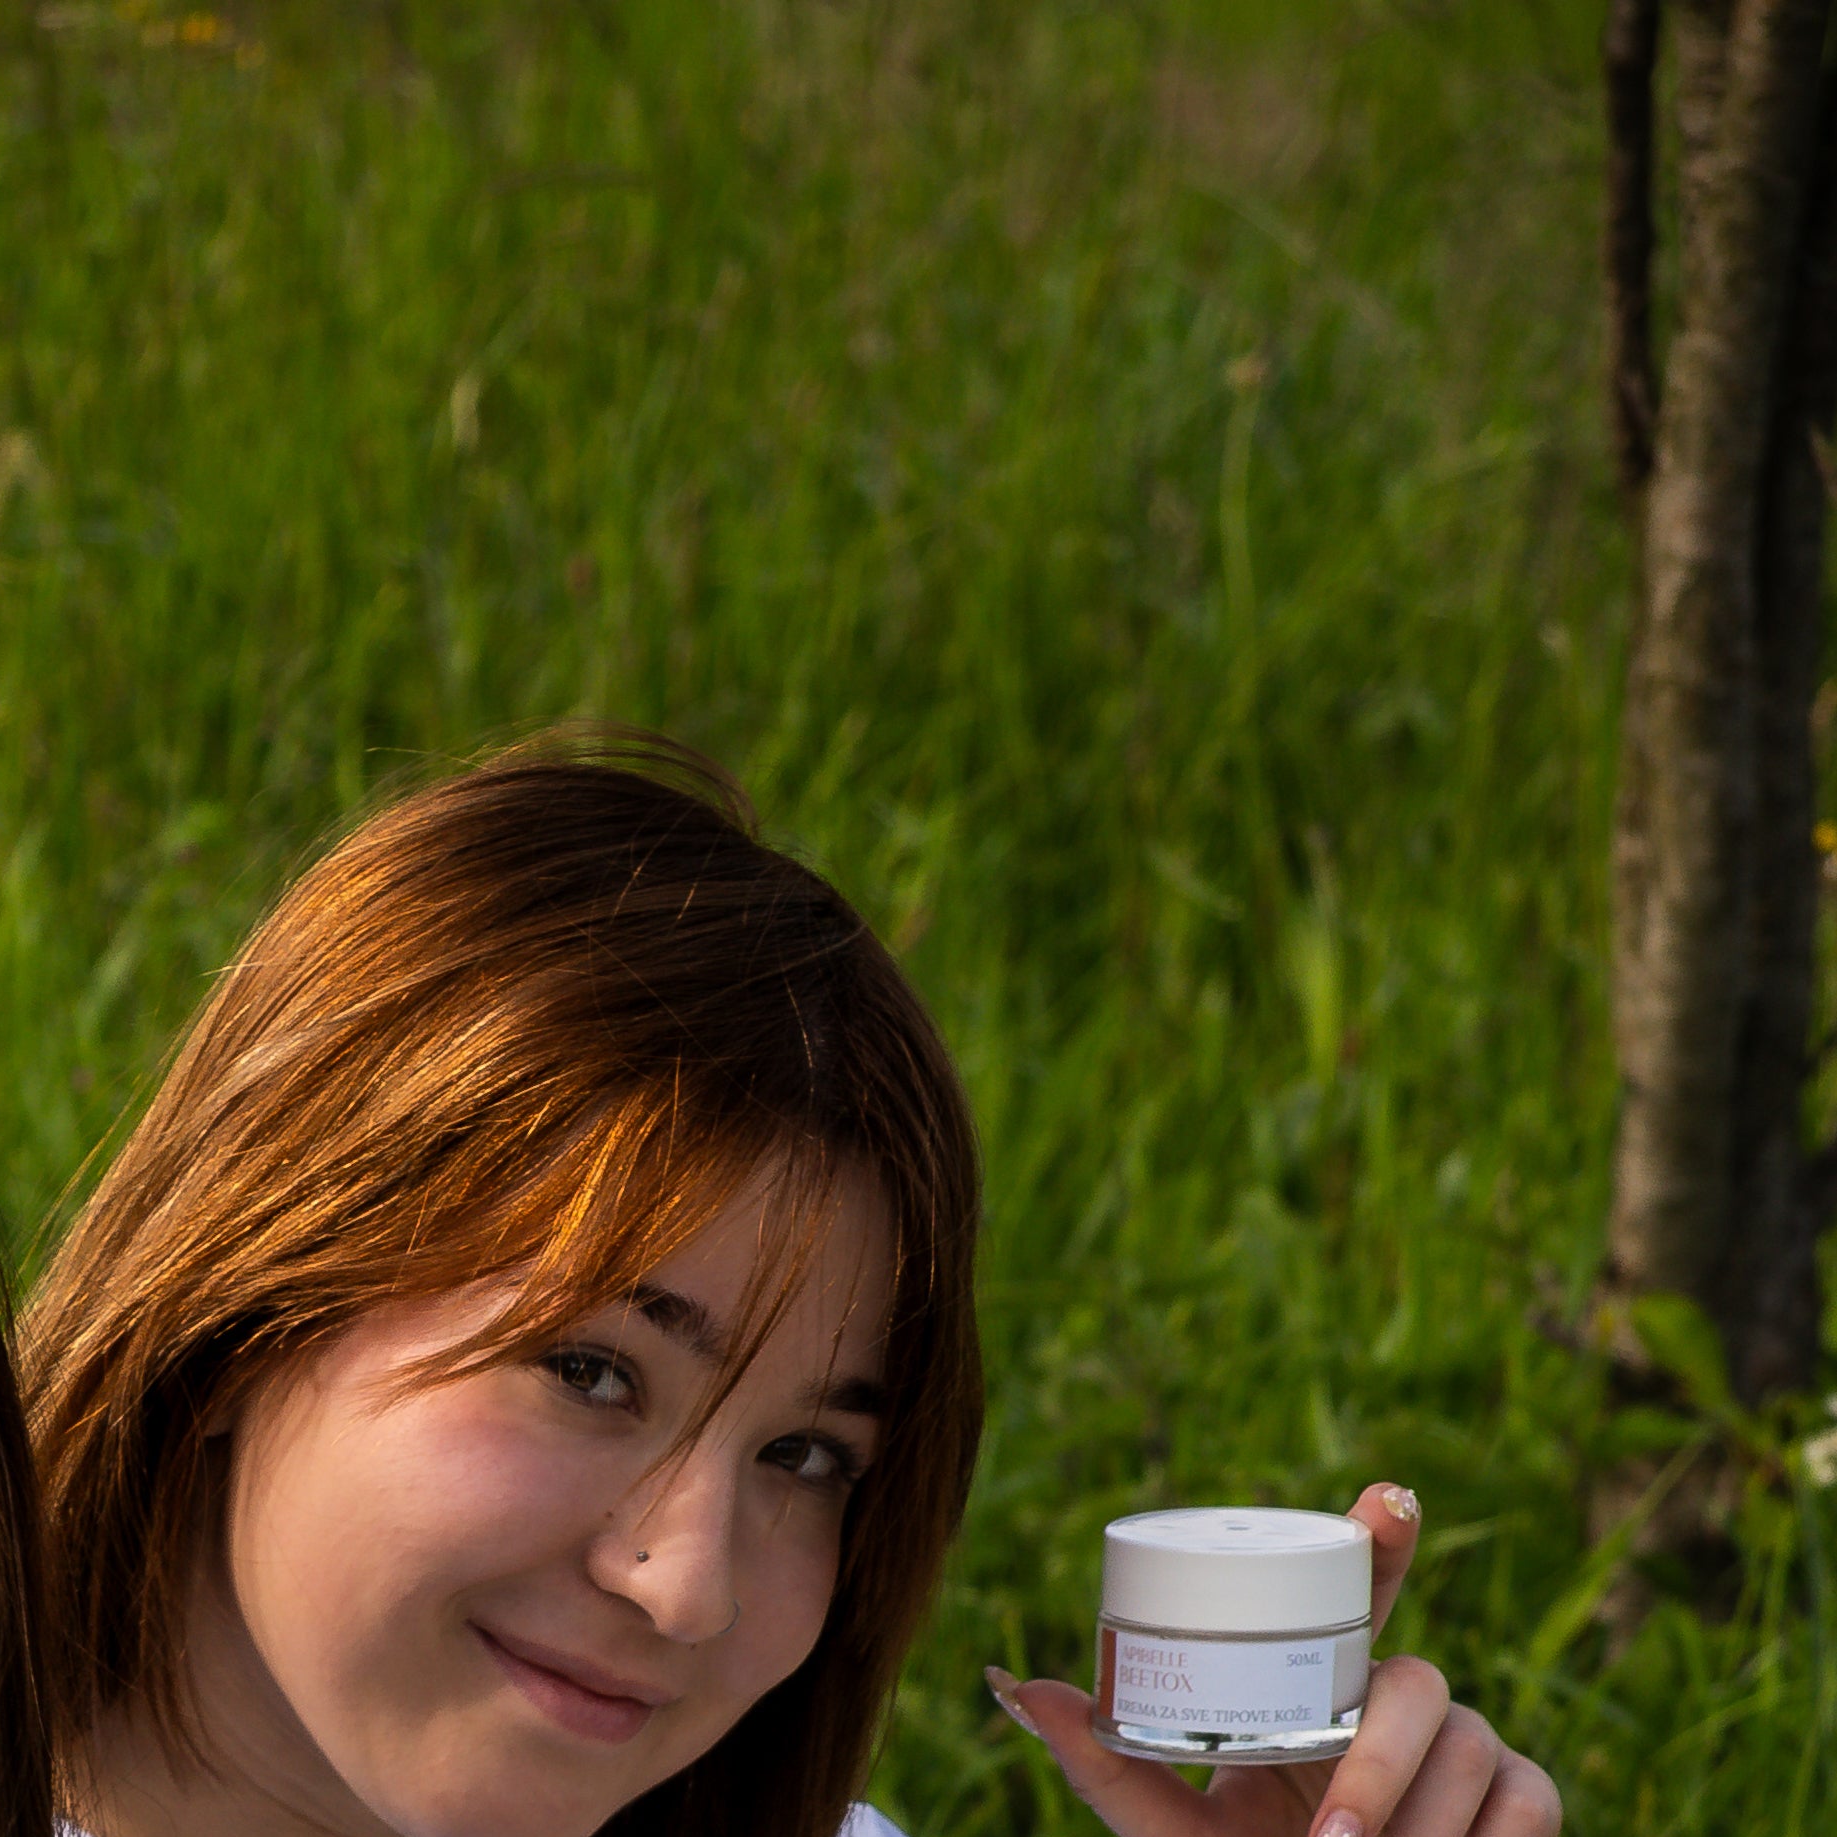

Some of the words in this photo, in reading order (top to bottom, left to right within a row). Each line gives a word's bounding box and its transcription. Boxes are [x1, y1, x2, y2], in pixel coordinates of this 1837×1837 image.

[1118, 1664, 1194, 1693] BEETOX
[1117, 1698, 1157, 1718] KREMA
[1160, 1705, 1178, 1720] ZA
[1181, 1707, 1209, 1722] SVE
[1213, 1709, 1270, 1724] TIPOVE
[1273, 1704, 1314, 1722] KOŽE
